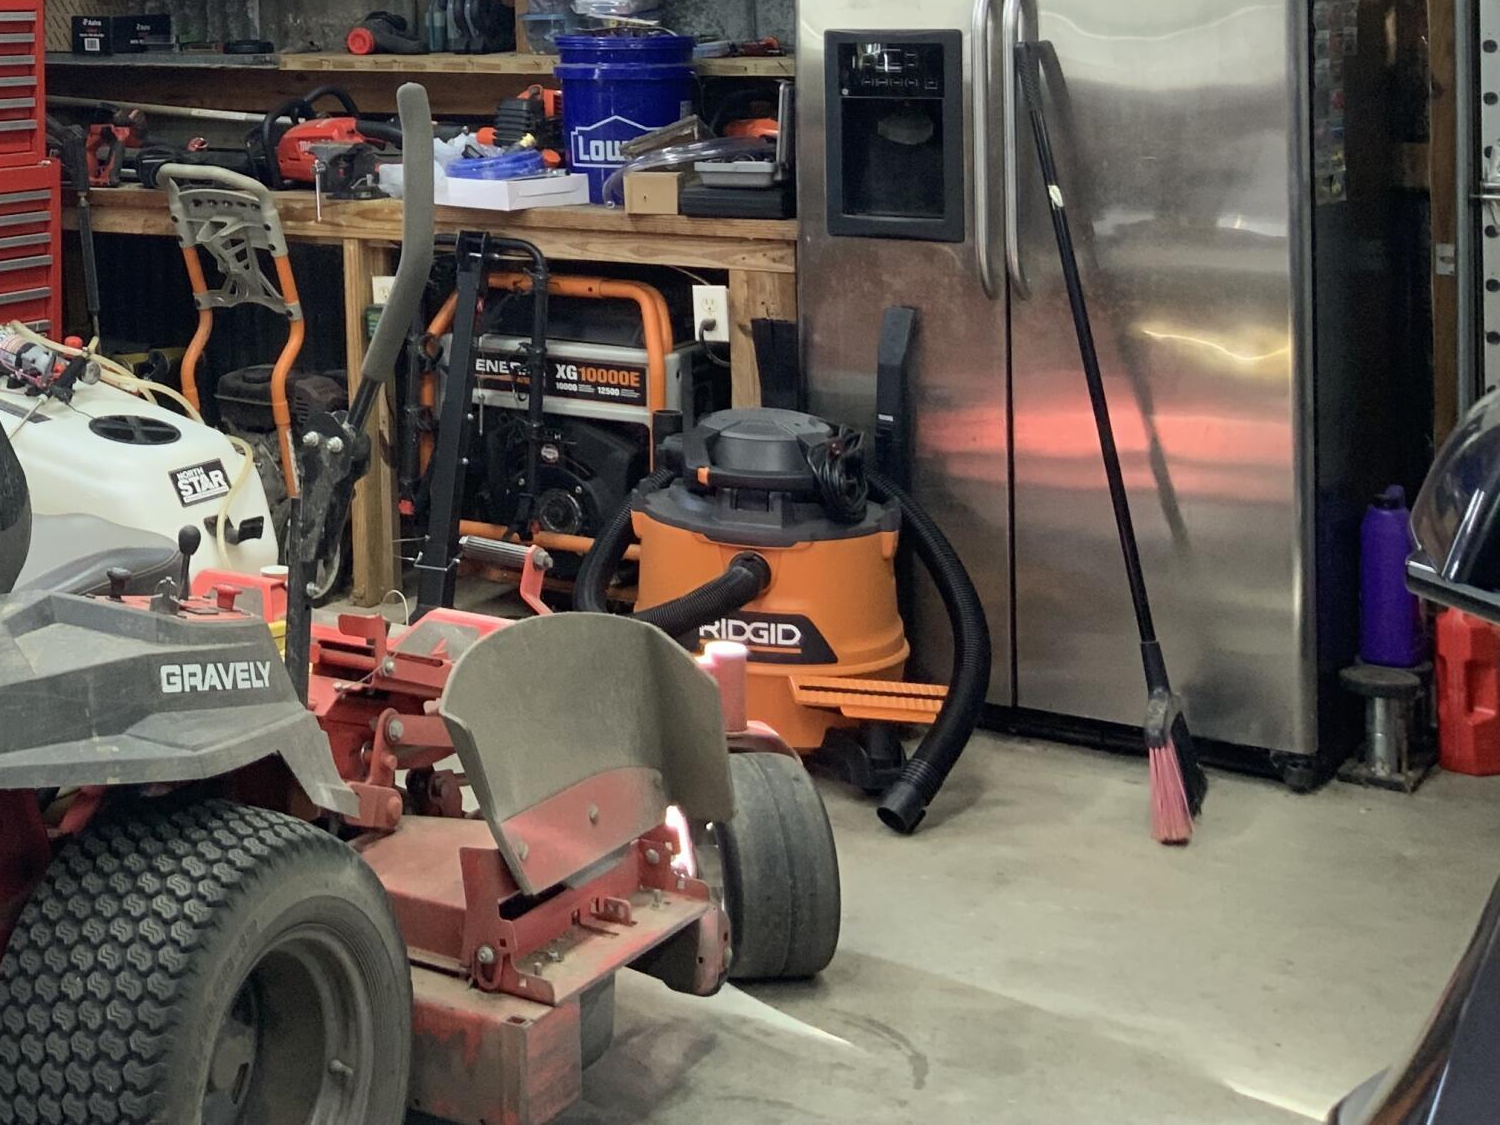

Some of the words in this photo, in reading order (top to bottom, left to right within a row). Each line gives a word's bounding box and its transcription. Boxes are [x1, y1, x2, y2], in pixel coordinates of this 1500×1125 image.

[176, 466, 205, 481] NORTH
[177, 469, 228, 497] STAR
[699, 618, 801, 645] RIDGID
[160, 661, 270, 693] GRAVELY
